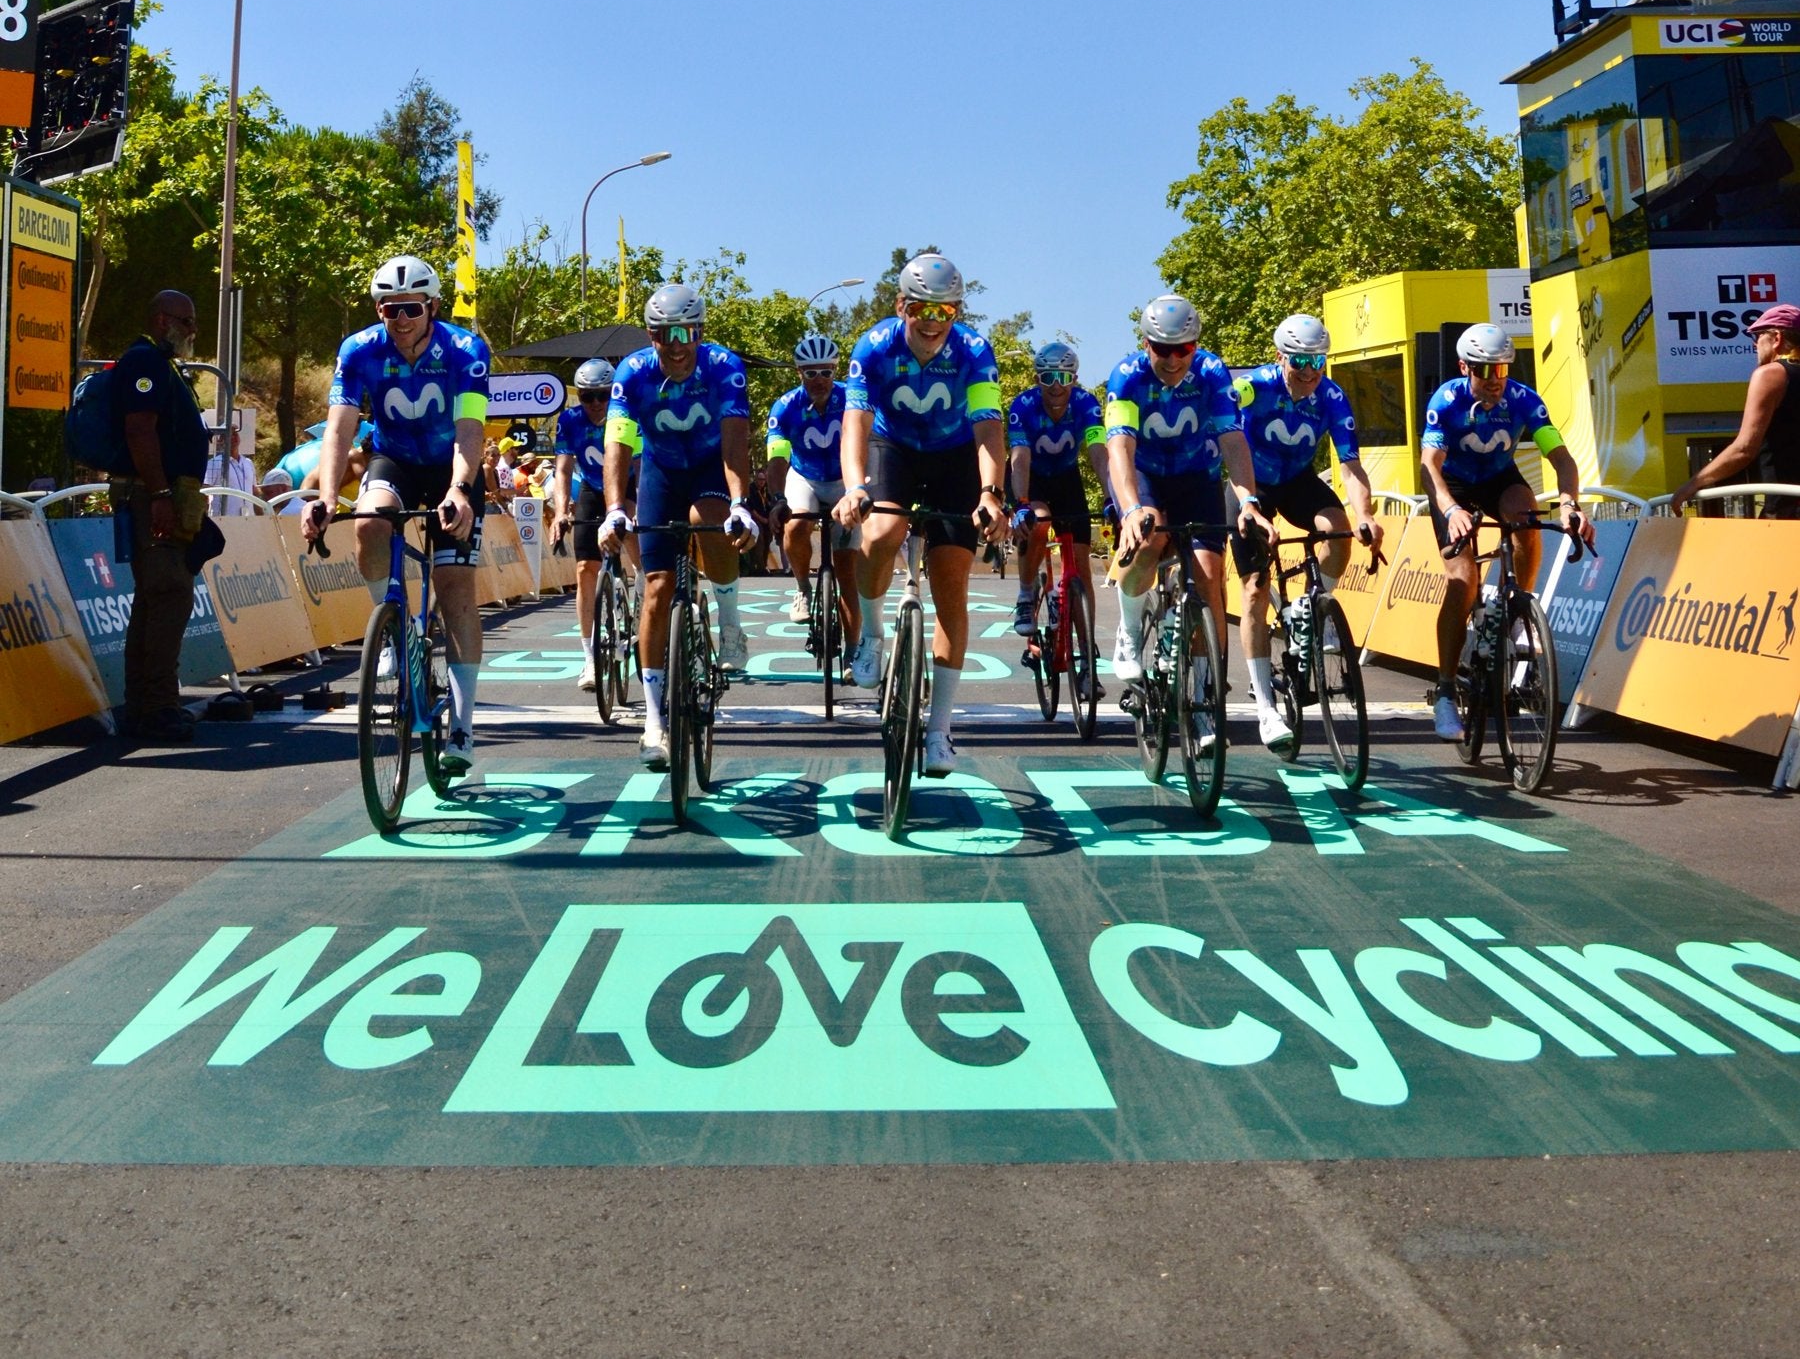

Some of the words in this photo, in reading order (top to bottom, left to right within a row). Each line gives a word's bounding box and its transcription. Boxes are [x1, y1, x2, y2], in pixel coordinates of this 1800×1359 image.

[1665, 24, 1714, 43] UCI
[1750, 22, 1792, 32] WORLD
[1753, 32, 1783, 42] TOUR
[18, 205, 71, 248] BARCELONA
[18, 260, 60, 292] Continental
[16, 312, 60, 343] Continental
[1670, 346, 1707, 356] SWISS
[15, 365, 58, 396] Continental
[513, 432, 528, 446] 25
[213, 559, 282, 624] Continental
[1548, 596, 1606, 637] TISSOT
[1615, 575, 1775, 656] Continental
[92, 926, 482, 1070] We
